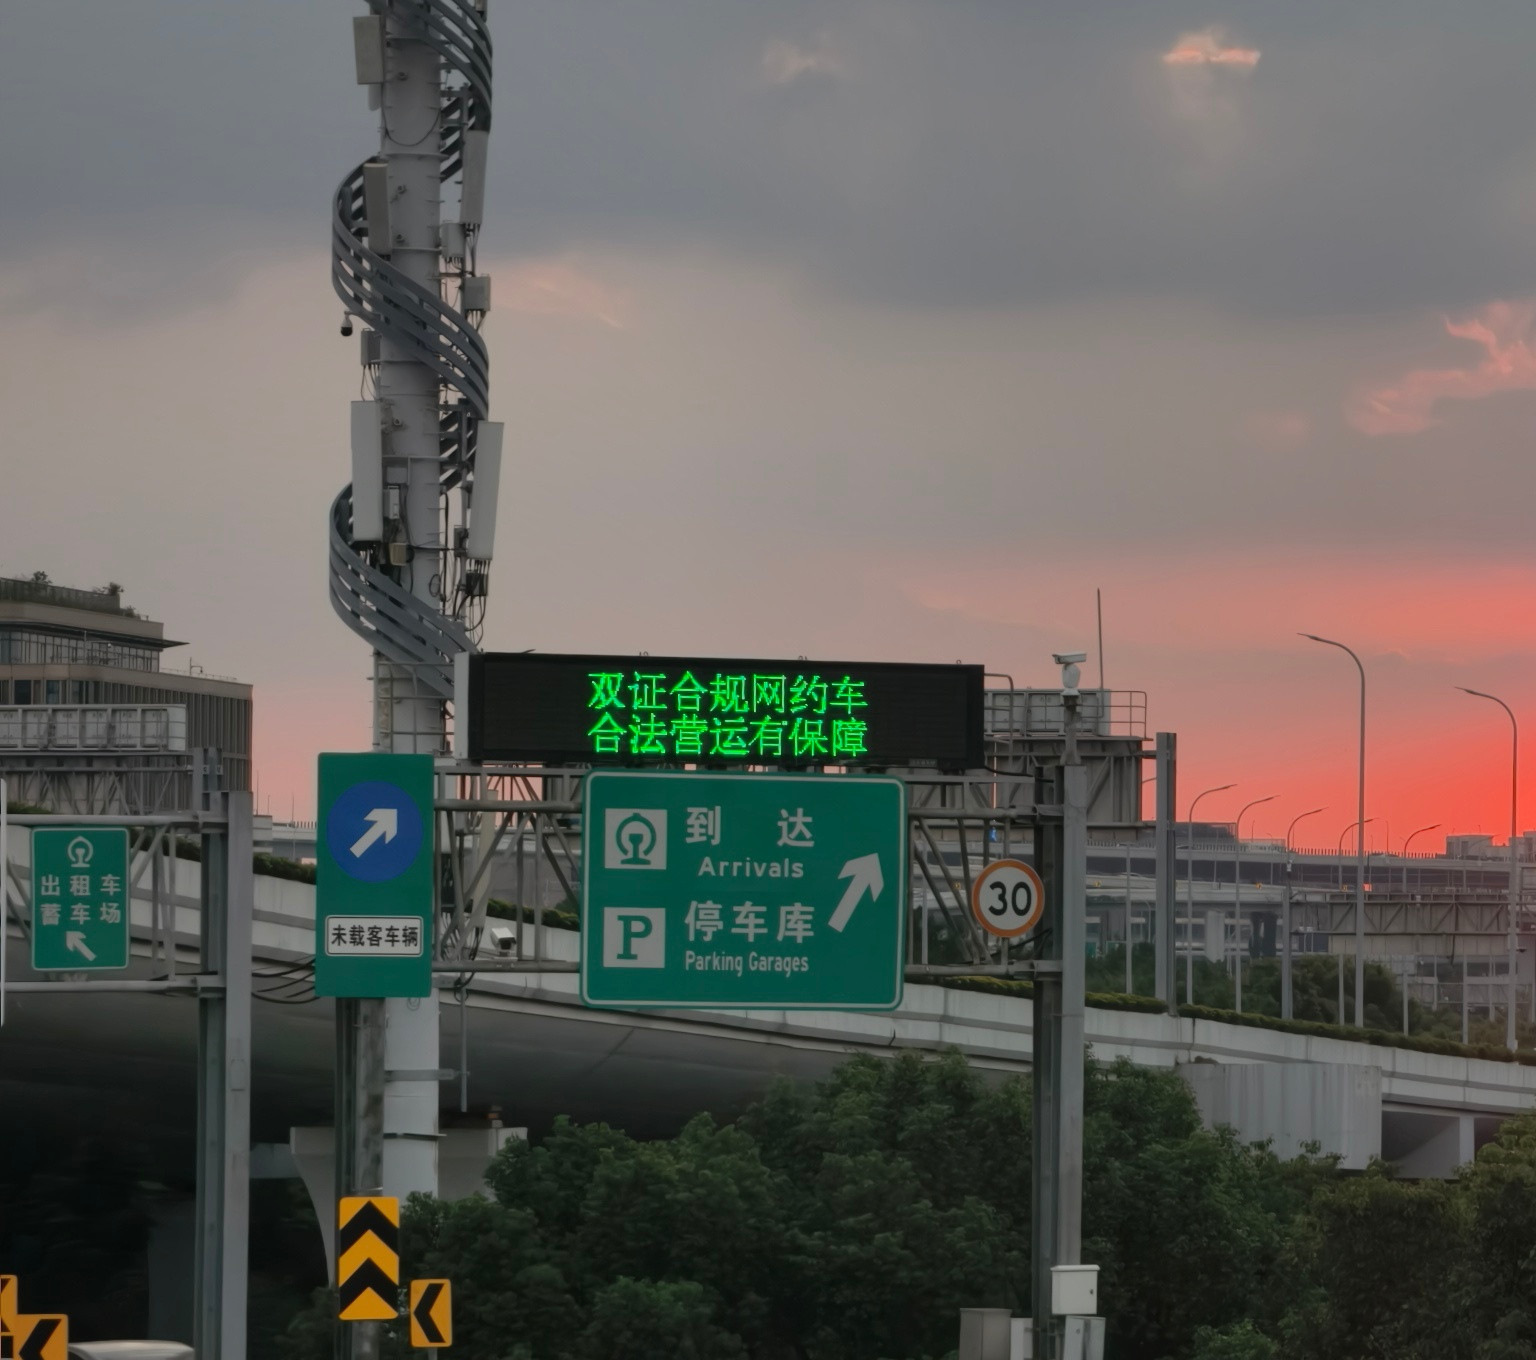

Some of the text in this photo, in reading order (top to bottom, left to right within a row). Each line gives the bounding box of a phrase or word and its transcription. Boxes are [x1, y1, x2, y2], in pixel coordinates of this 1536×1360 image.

[588, 671, 868, 714] 双证合规网约车
[587, 712, 868, 757] 合法营运有保障
[685, 806, 815, 847] 到达
[41, 874, 121, 896] 出租车
[698, 857, 804, 878] Arrivals
[41, 902, 121, 925] 蓄车场
[988, 881, 1032, 916] 30
[331, 924, 418, 947] 未载客车辆
[617, 915, 653, 960] P
[684, 900, 815, 943] 停车库
[685, 950, 809, 977] Parking Garages
